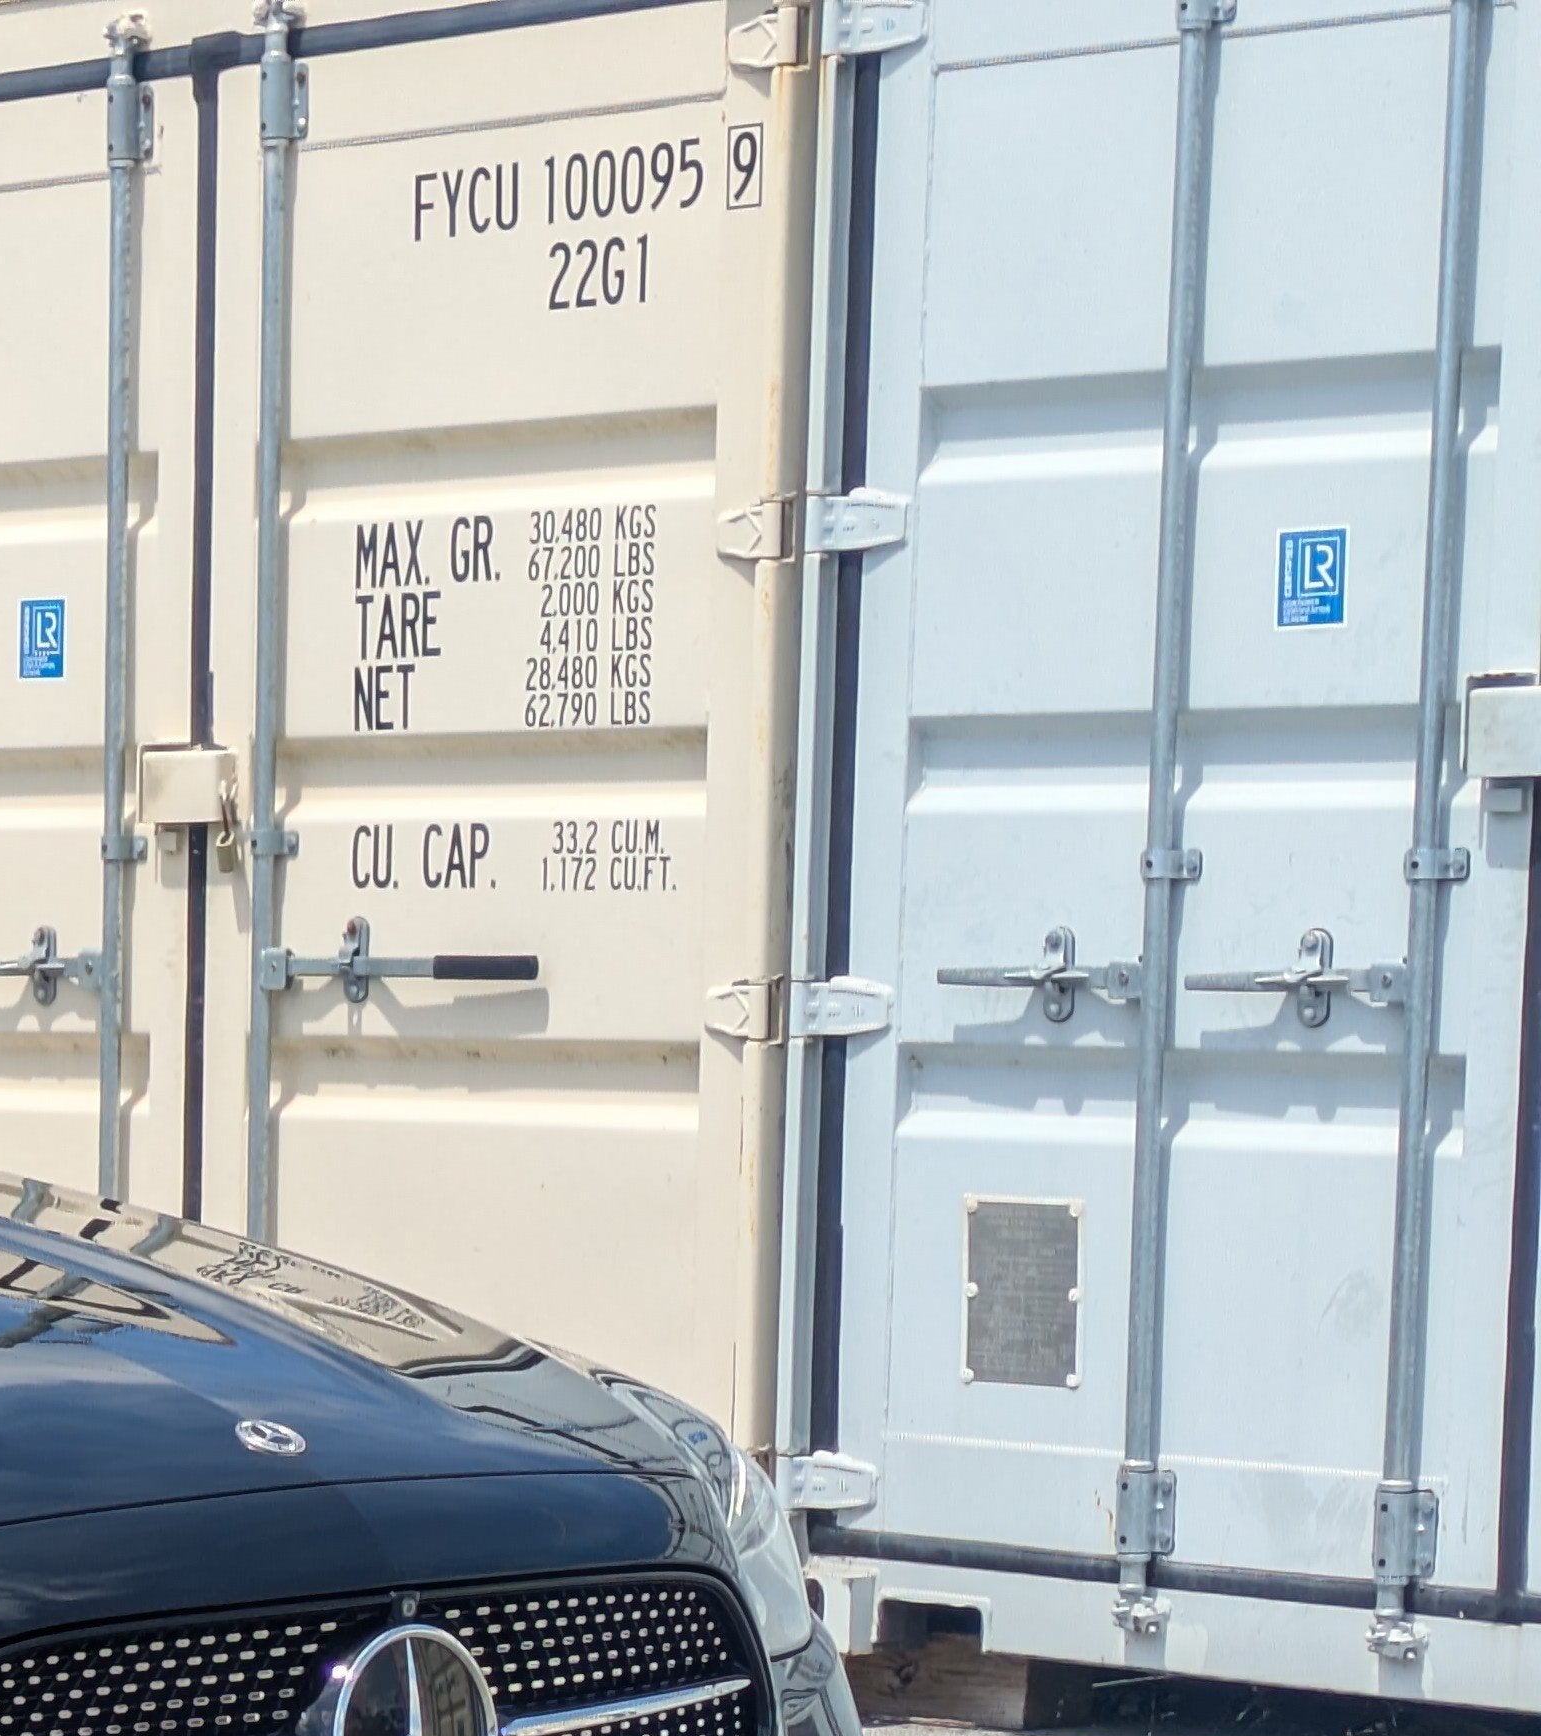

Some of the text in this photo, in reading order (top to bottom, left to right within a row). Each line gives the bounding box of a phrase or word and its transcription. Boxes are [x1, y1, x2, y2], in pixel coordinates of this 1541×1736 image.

[414, 131, 758, 242] FYCU 100095 9
[548, 233, 648, 311] 22G1
[614, 504, 657, 540] KGS
[355, 515, 501, 590] MAX. GR.
[613, 541, 655, 578] LBS
[612, 578, 654, 615] KGS
[355, 590, 442, 661] TARE
[611, 616, 653, 652] LBS
[610, 653, 652, 689] KGS
[354, 663, 416, 732] NET
[610, 690, 651, 726] LBS
[611, 819, 665, 854] CU.M.
[352, 822, 497, 890] CU. CAP.
